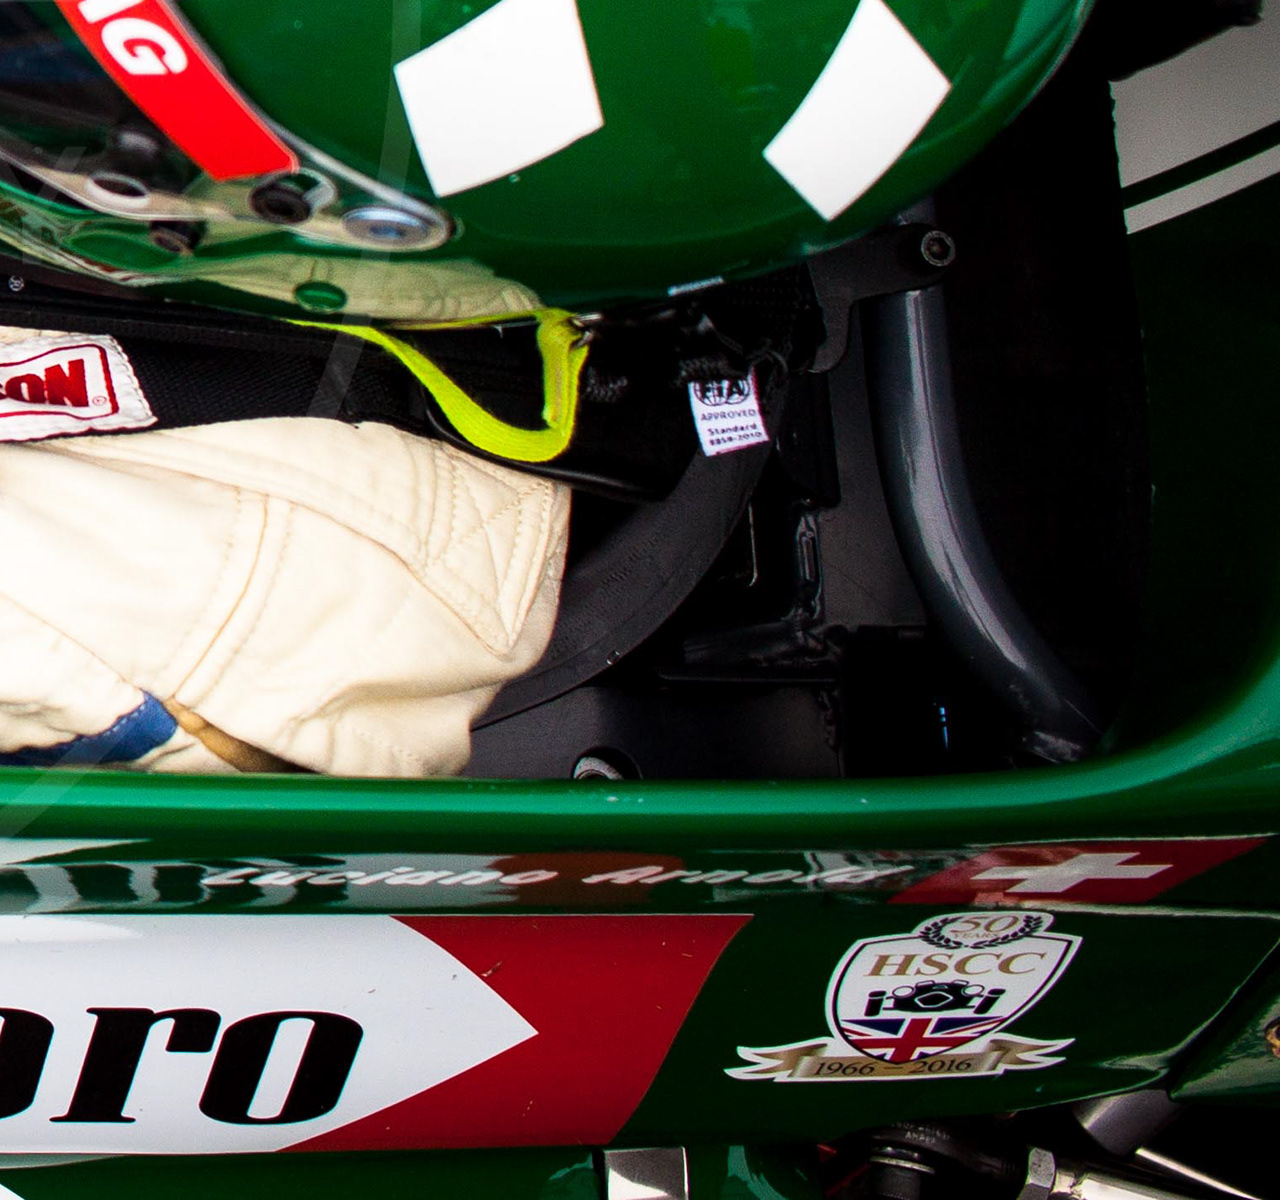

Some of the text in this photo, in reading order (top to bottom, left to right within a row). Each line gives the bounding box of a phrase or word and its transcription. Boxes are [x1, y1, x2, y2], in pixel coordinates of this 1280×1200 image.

[700, 408, 757, 421] APPROVED
[707, 422, 758, 436] Standard
[950, 915, 1020, 934] 50
[862, 952, 1048, 977] HSCC
[813, 1061, 877, 1076] 1966
[907, 1057, 973, 1075] 2016
